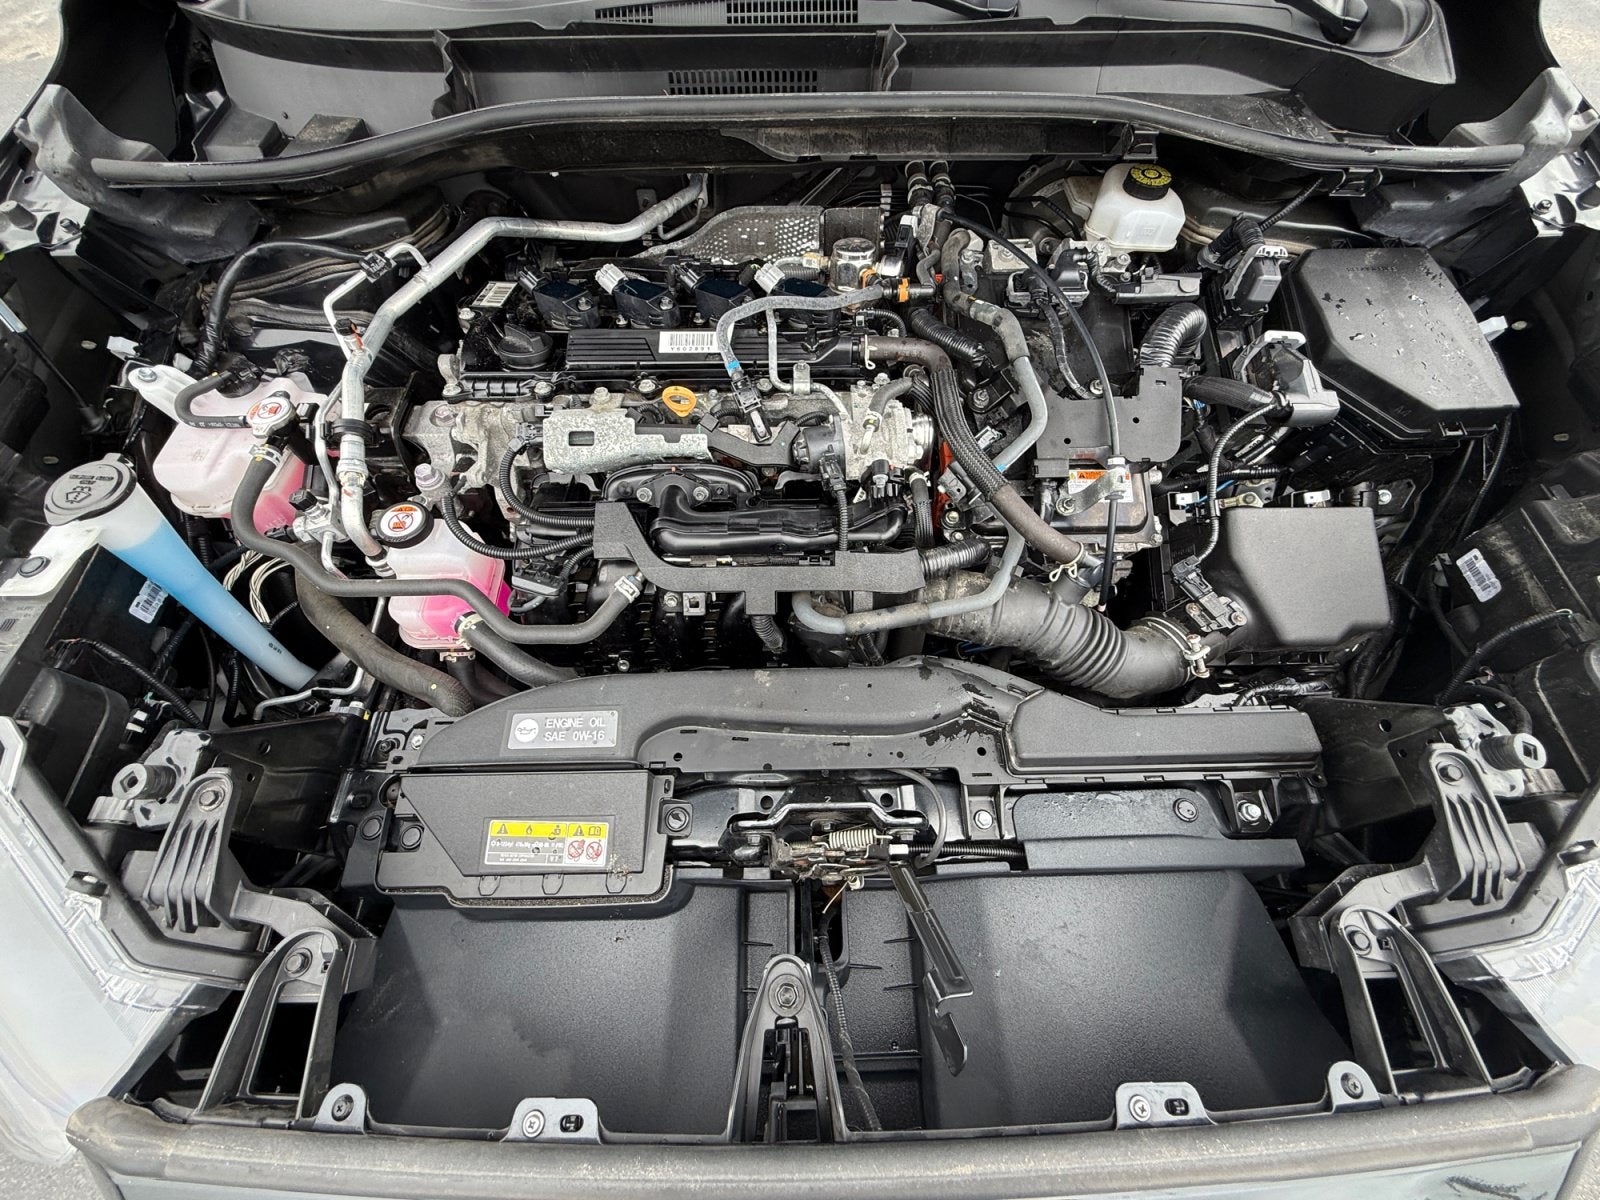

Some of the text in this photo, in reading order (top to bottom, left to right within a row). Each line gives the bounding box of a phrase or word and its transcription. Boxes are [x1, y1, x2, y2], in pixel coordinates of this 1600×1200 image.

[544, 717, 606, 729] ENGINE OIL
[544, 730, 605, 742] SAE 0W-16
